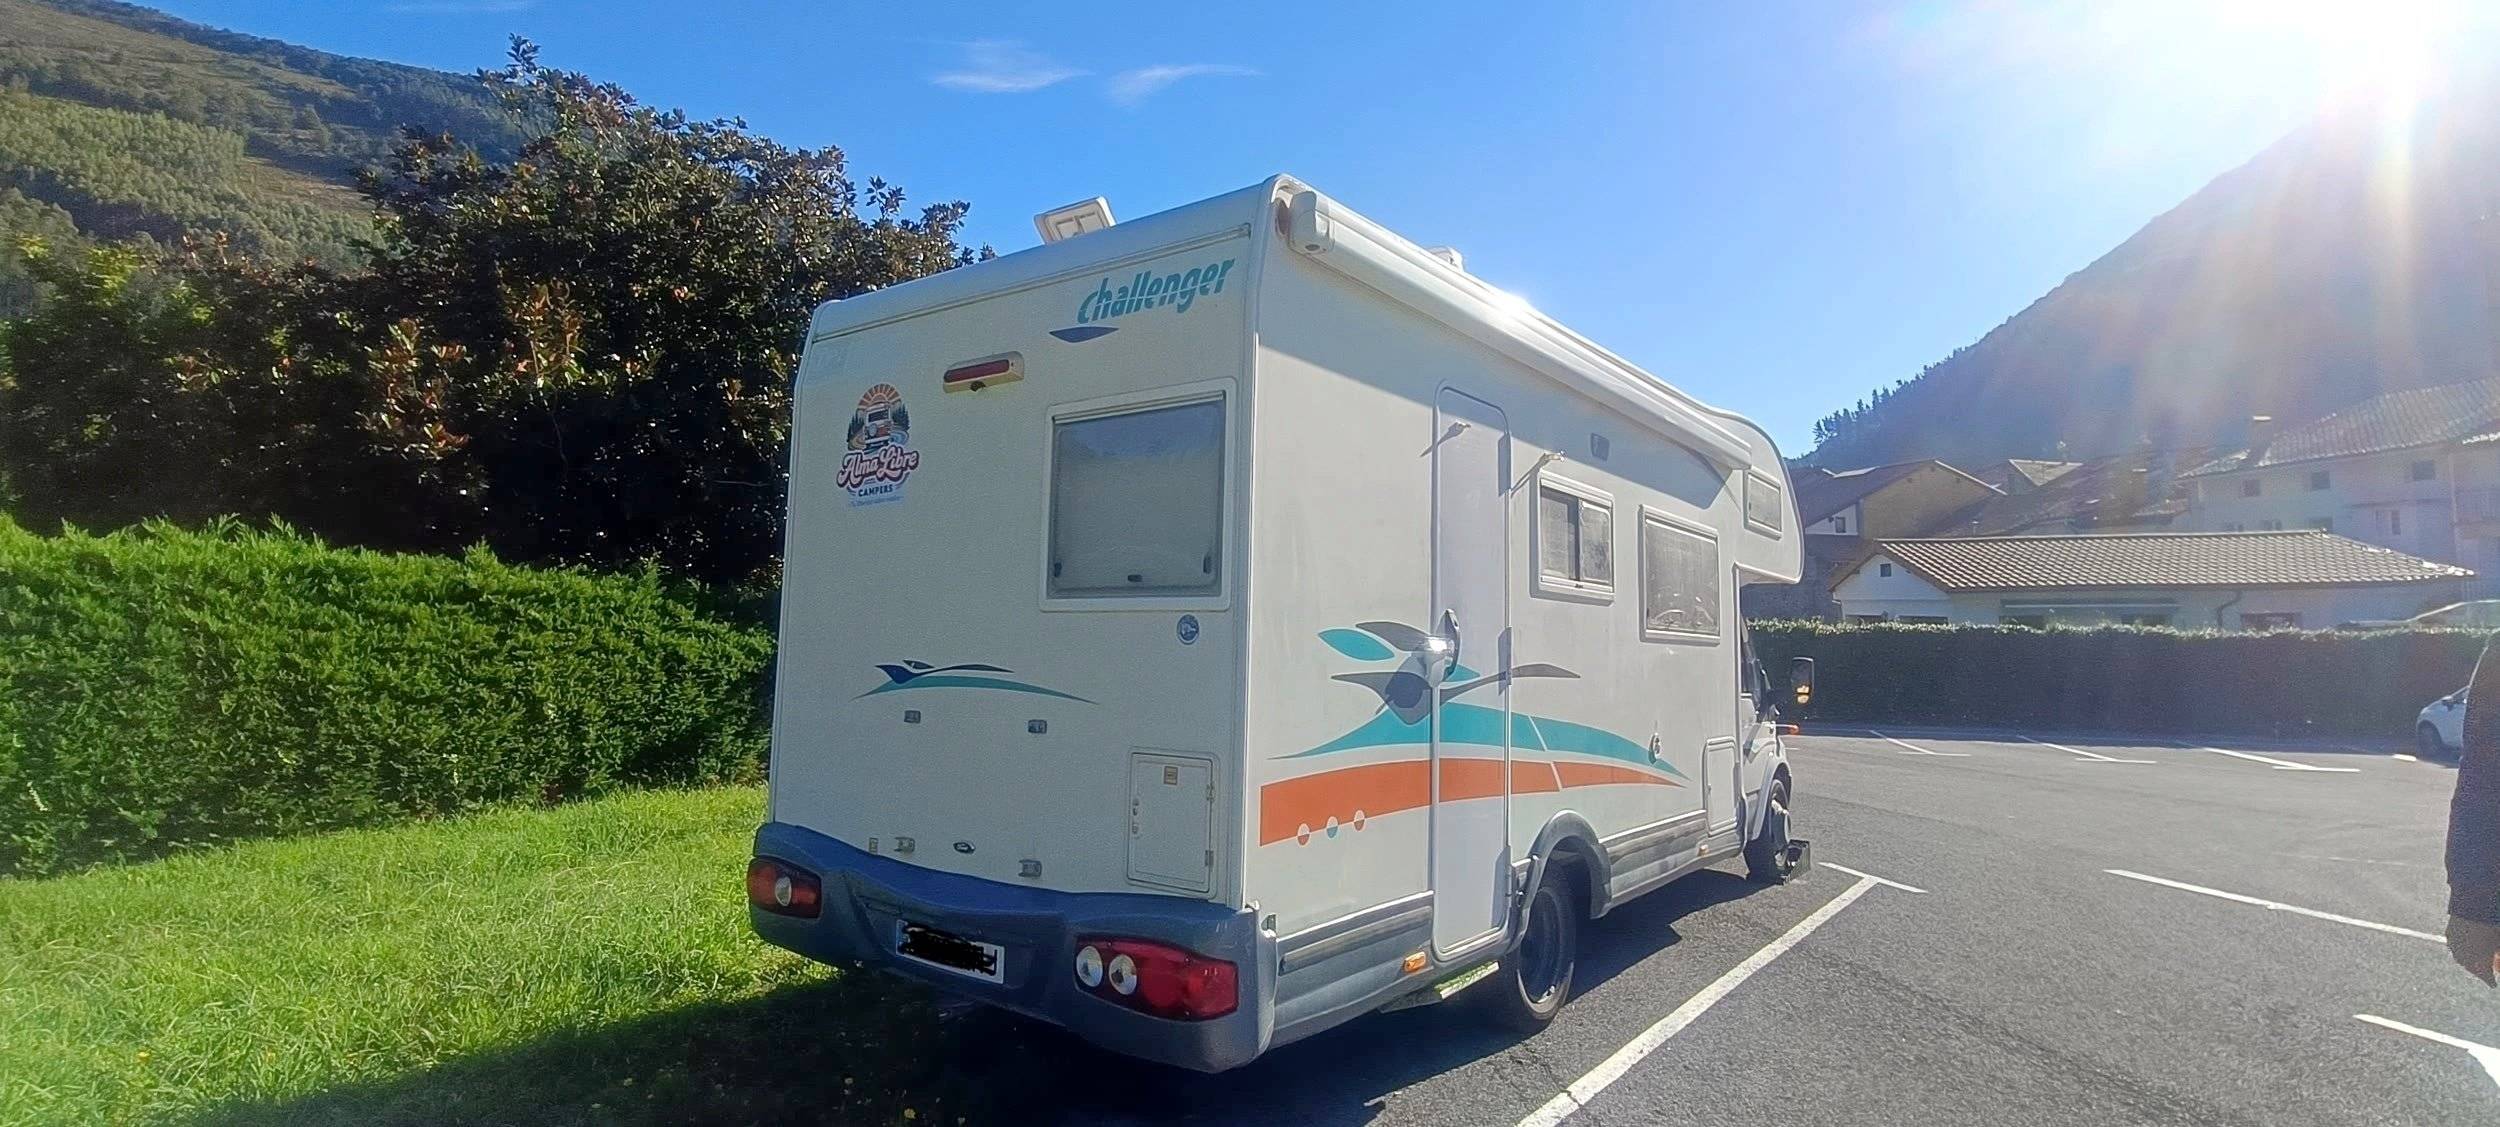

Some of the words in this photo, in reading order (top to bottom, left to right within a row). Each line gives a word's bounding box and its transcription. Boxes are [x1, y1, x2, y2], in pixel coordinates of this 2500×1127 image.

[837, 453, 880, 488] Alma
[876, 444, 919, 481] Libre
[858, 484, 894, 497] CAMPERS
